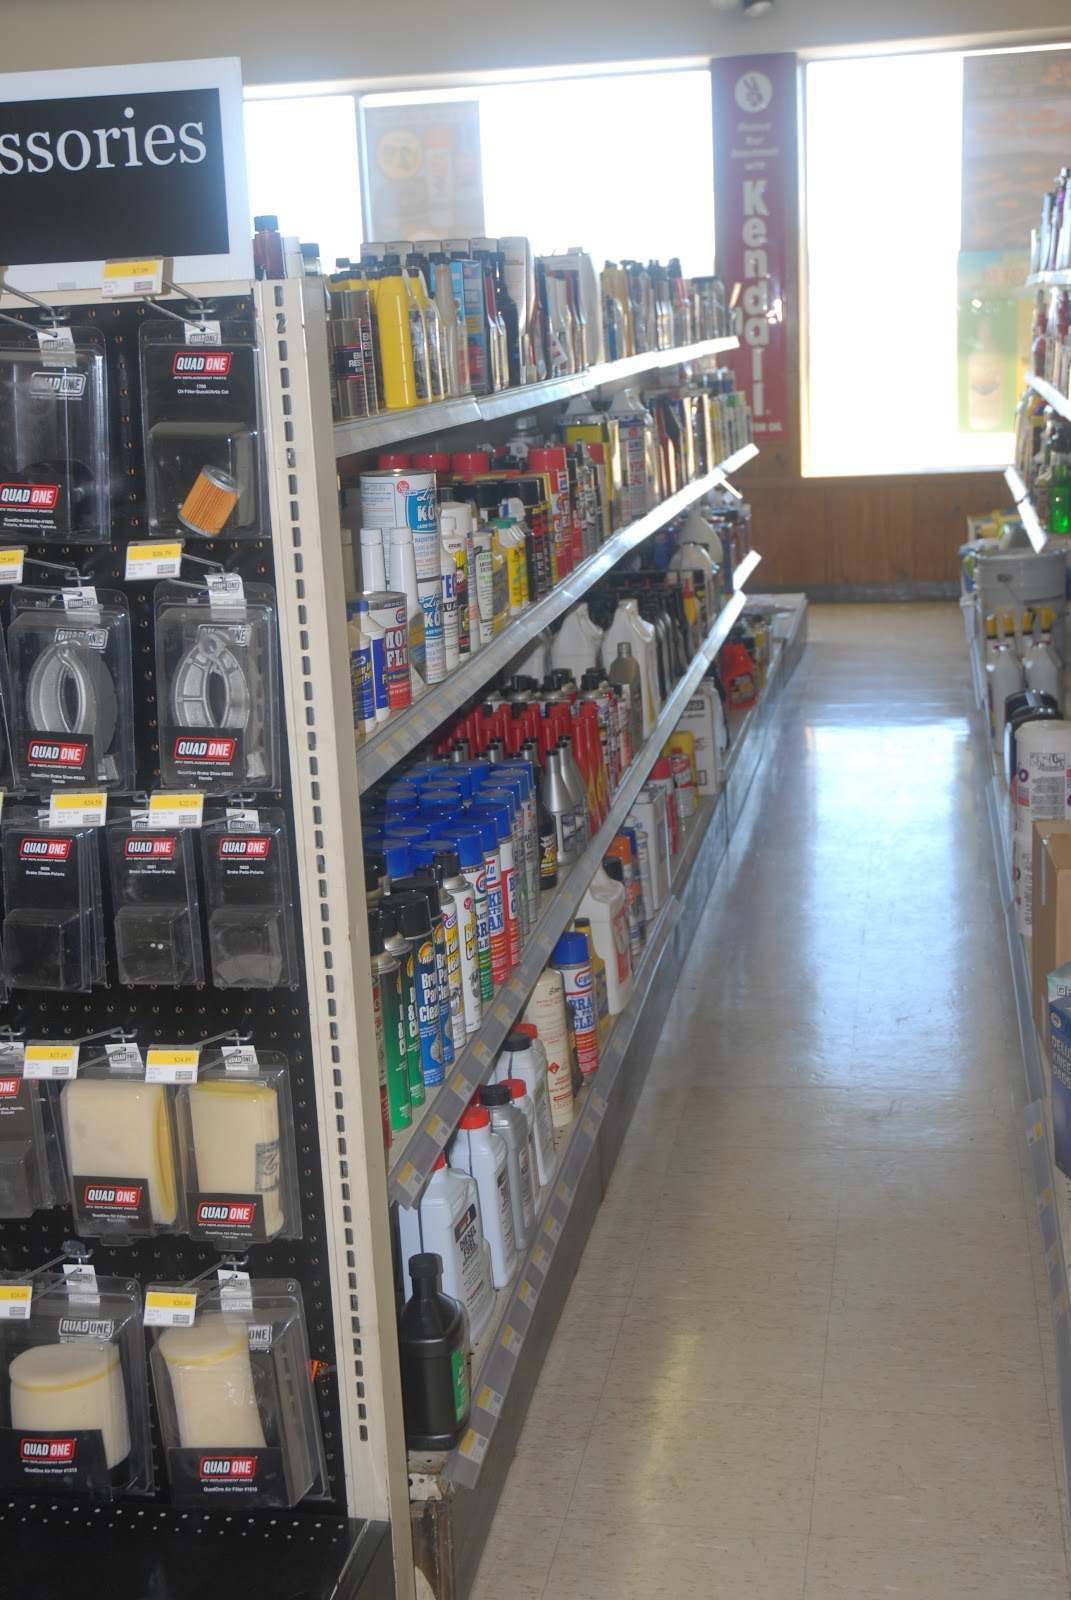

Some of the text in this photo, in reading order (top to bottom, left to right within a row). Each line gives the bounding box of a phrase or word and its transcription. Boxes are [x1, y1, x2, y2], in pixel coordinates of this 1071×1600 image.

[0, 107, 206, 175] ssories
[742, 180, 769, 416] Kendall
[176, 357, 227, 371] QUAD ONE
[1, 488, 54, 504] QUAD ONE
[31, 745, 82, 760] QUAD ONE
[178, 741, 230, 756] QUAD ONE
[23, 841, 67, 855] QUAD ONE
[128, 841, 172, 853] QUAD ONE
[222, 841, 267, 853] QUAD ONE
[88, 1189, 137, 1203] QUAD ONE
[201, 1206, 250, 1220] QUAD ONE
[62, 1321, 111, 1334] QUAD ONE
[23, 1443, 71, 1456] QUAD ONE
[203, 1460, 252, 1473] QUAD ONE
